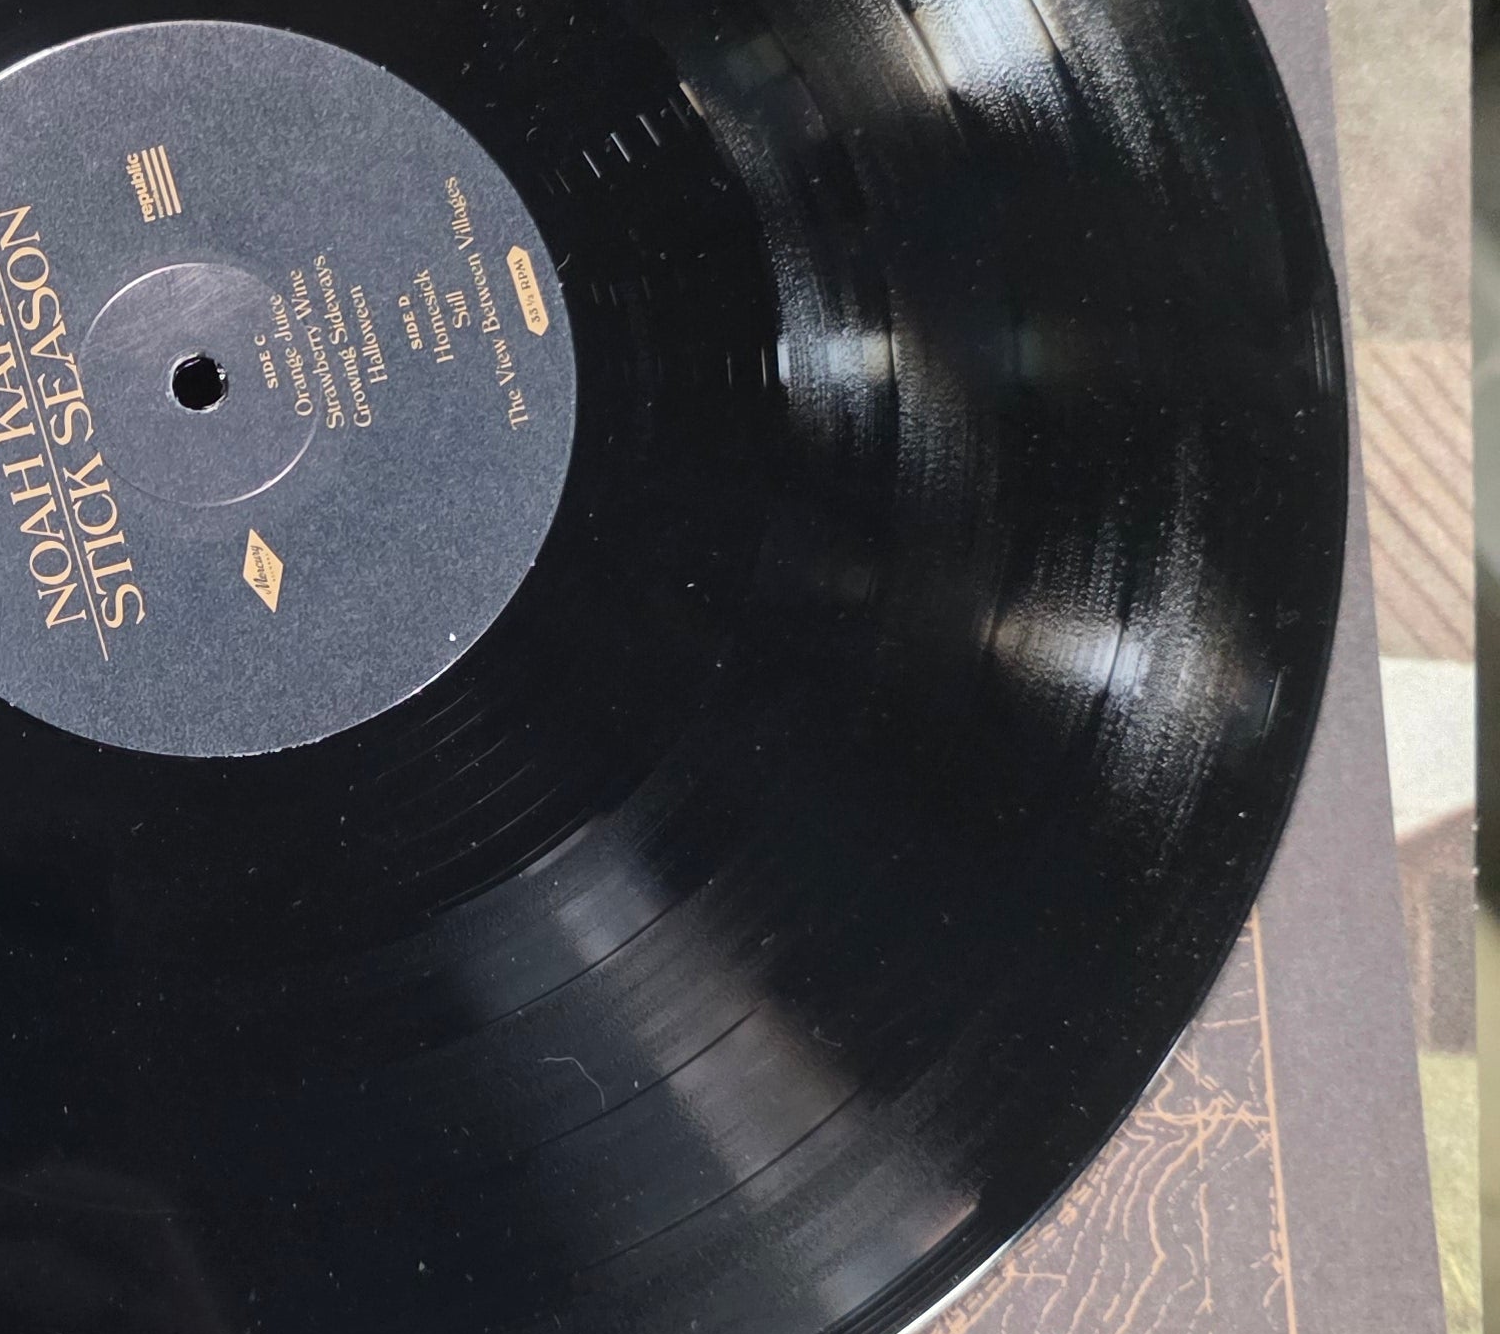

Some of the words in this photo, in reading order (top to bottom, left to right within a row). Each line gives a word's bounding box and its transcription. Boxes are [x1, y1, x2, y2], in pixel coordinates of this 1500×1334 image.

[125, 152, 155, 223] republic
[444, 175, 475, 250] Villages
[290, 269, 312, 320] Wine
[313, 254, 348, 344] Sideways
[467, 252, 501, 334] Between
[512, 257, 532, 291] RPM
[270, 293, 293, 341] Juice
[397, 293, 412, 308] D
[413, 269, 453, 364] Homesick
[445, 290, 471, 329] Still
[529, 307, 541, 324] 33
[254, 335, 268, 347] C
[350, 284, 389, 384] Halloween
[402, 311, 424, 350] SIDE
[259, 350, 280, 390] SIDE
[285, 346, 314, 416] Orange
[307, 323, 346, 429] Strawberry
[337, 344, 372, 428] Growing
[493, 338, 516, 386] View
[508, 388, 529, 431] The
[3, 453, 88, 629] NOAH
[62, 452, 146, 629] STICK
[250, 545, 272, 595] Mercury
